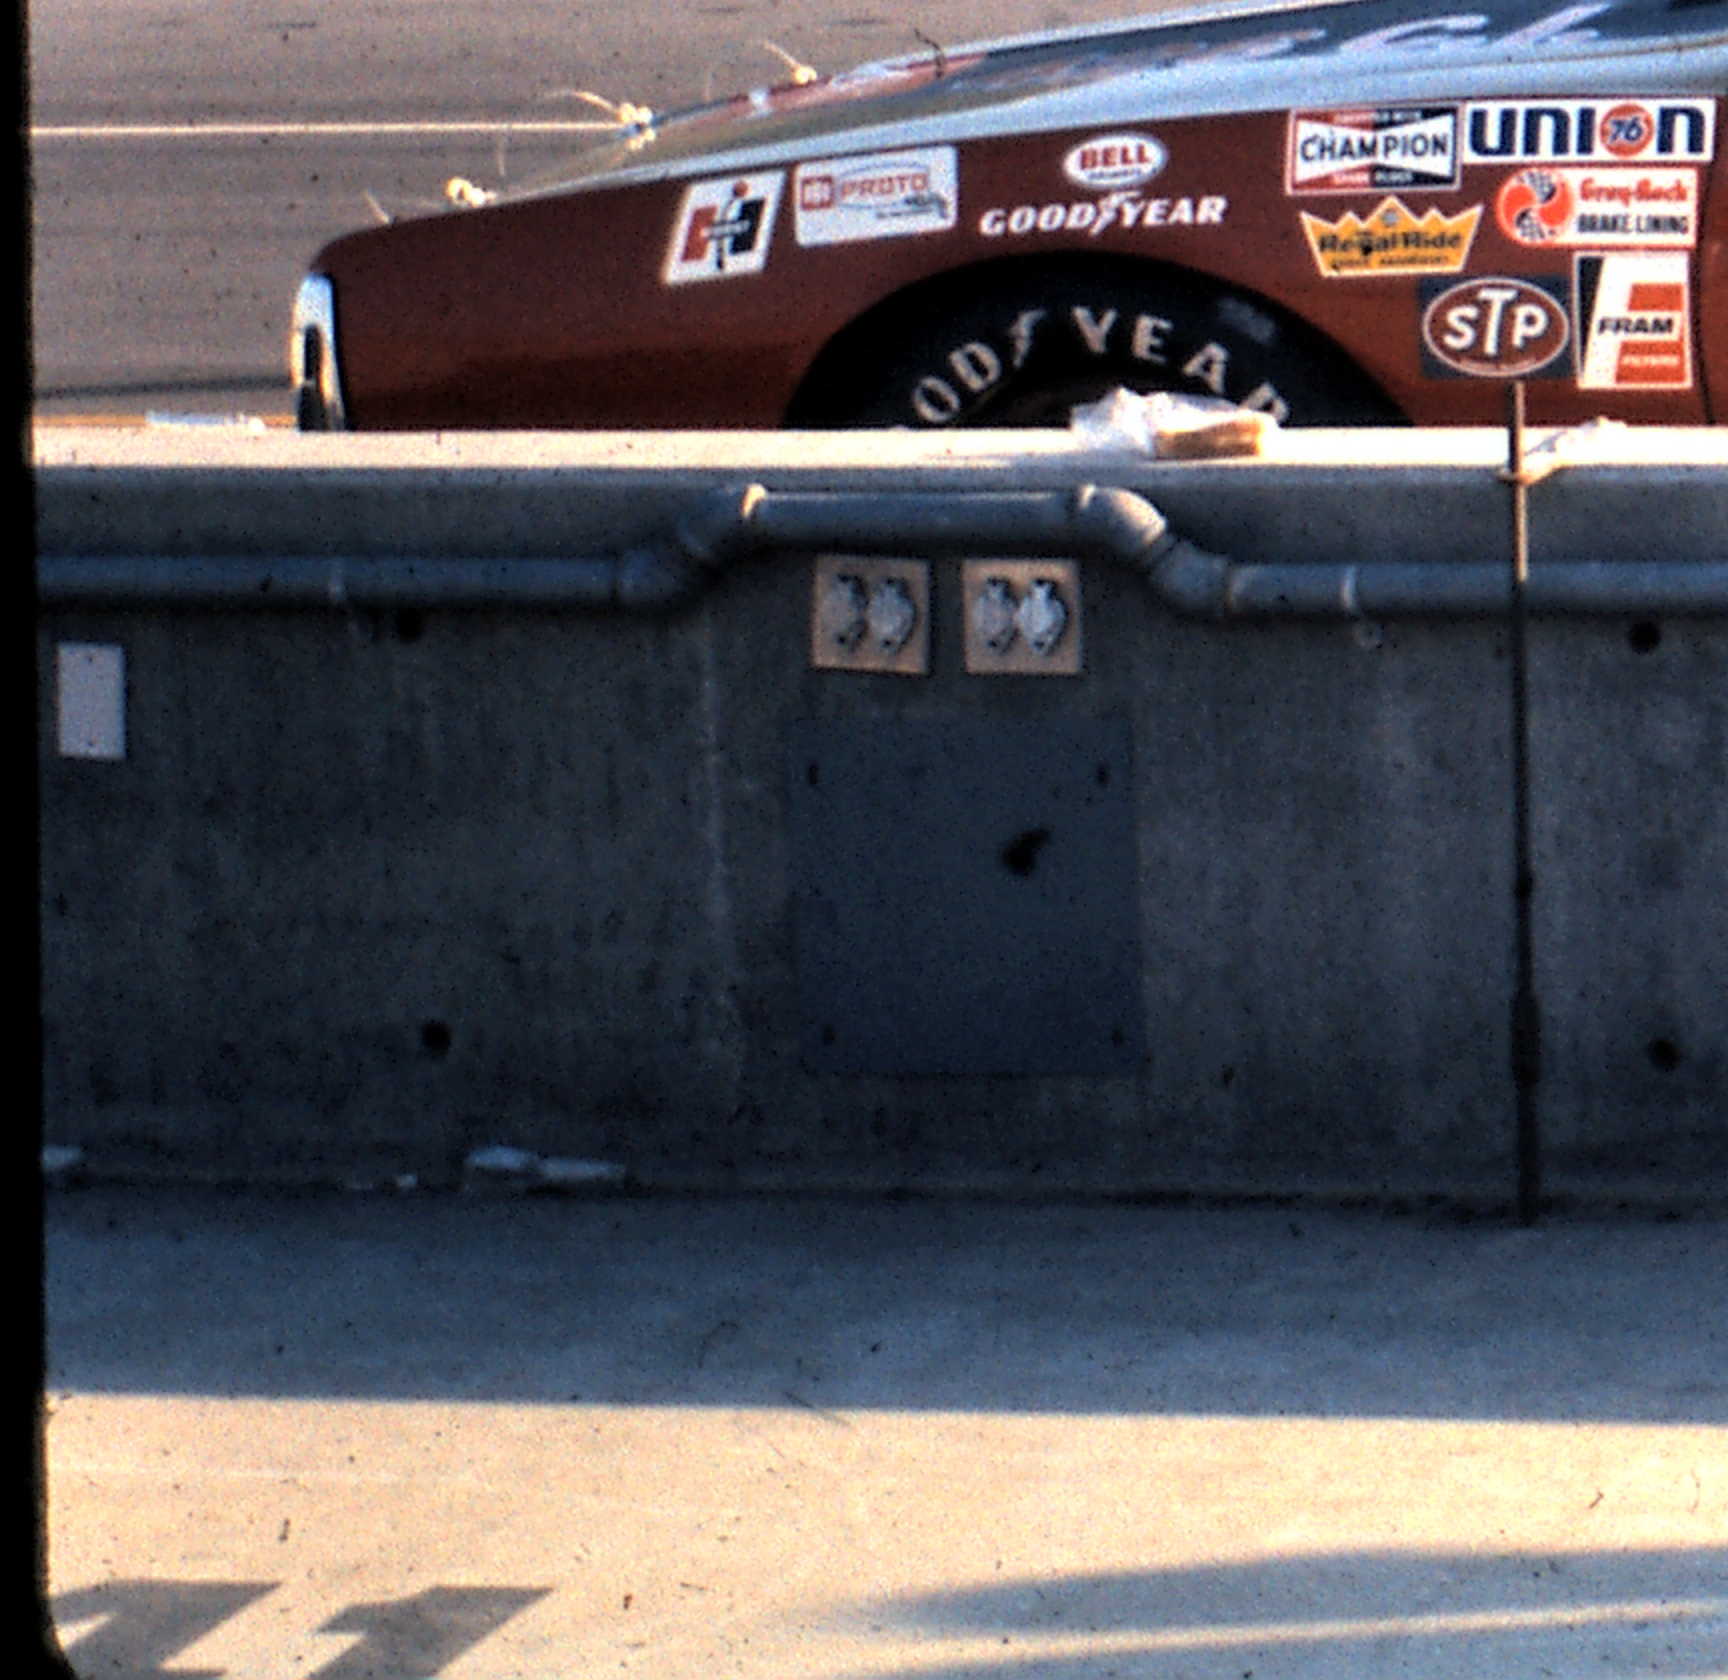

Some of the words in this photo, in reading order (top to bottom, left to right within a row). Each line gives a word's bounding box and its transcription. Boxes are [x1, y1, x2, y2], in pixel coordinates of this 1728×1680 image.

[1607, 116, 1644, 143] 76
[1080, 143, 1153, 171] BELL
[1301, 133, 1447, 161] CHAMPION
[841, 172, 929, 200] PROTO
[978, 192, 1228, 237] GOODYEAR
[1577, 213, 1632, 234] BRAKE
[1443, 288, 1549, 357] STP
[1597, 317, 1674, 335] FRAM
